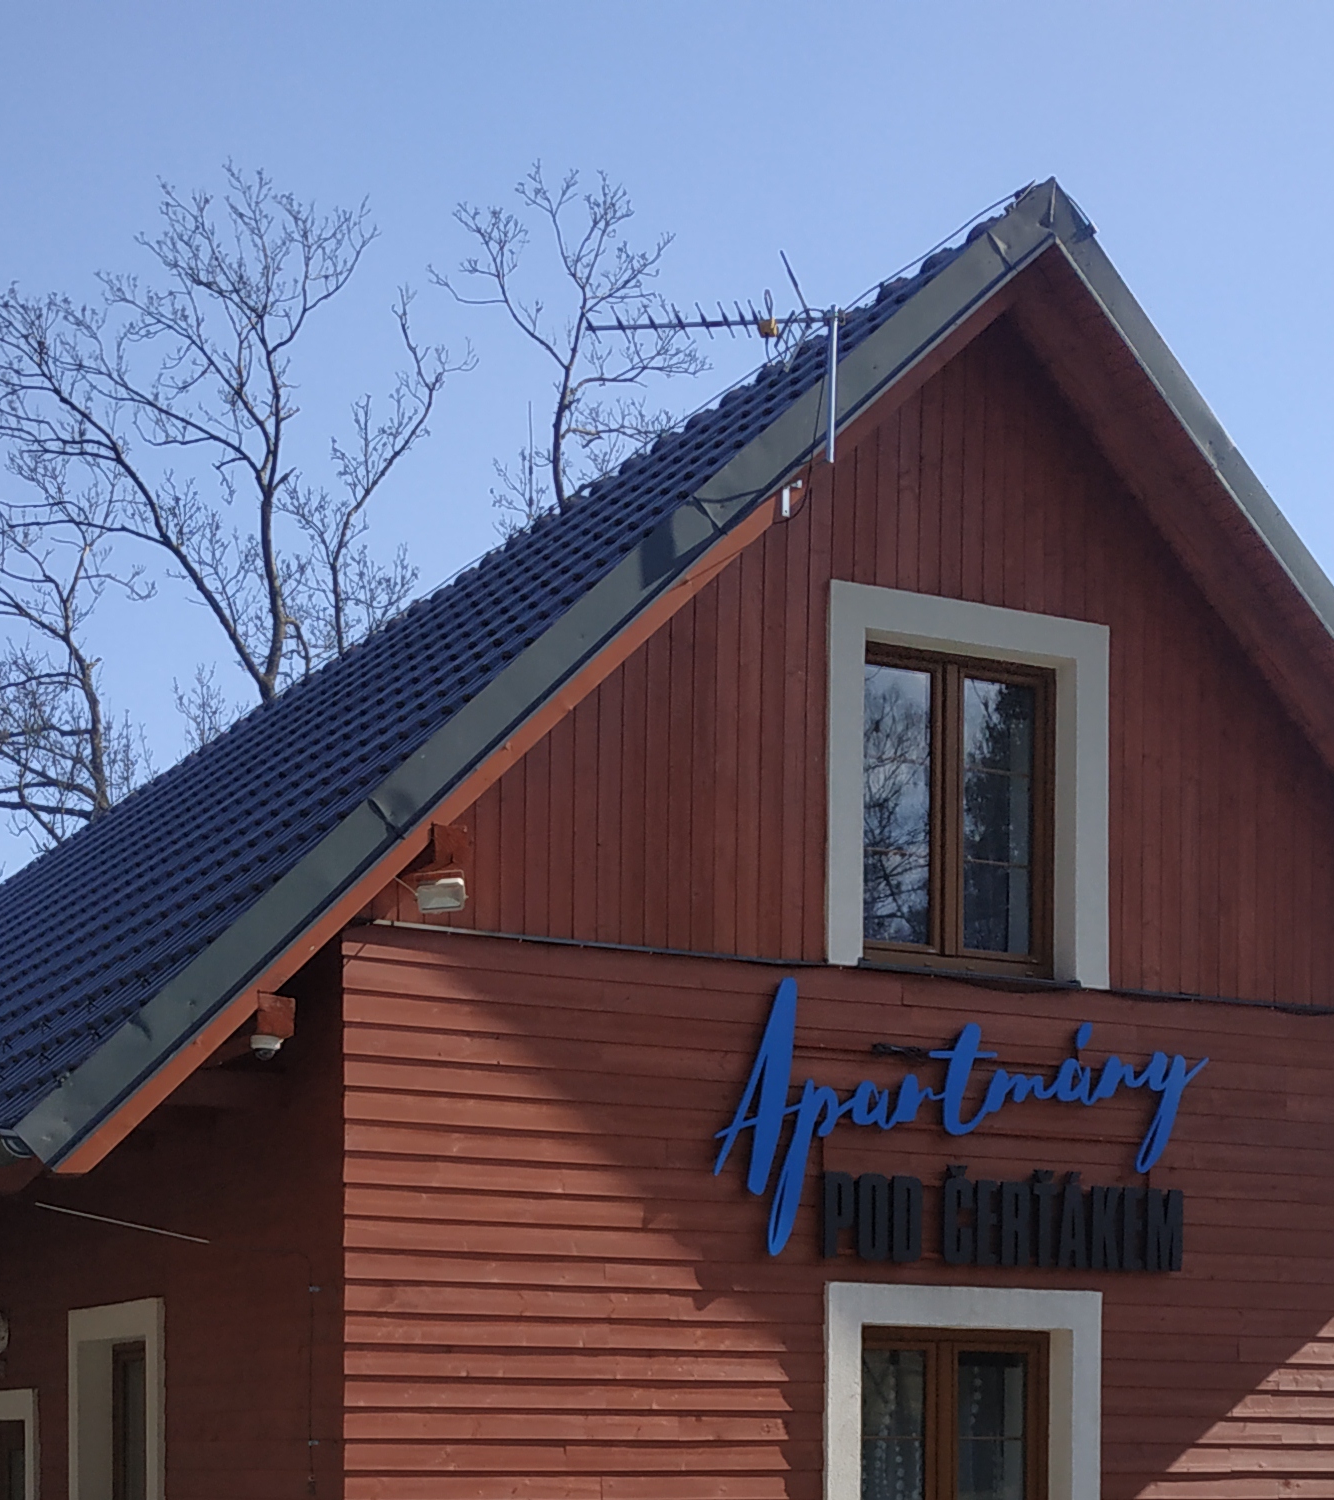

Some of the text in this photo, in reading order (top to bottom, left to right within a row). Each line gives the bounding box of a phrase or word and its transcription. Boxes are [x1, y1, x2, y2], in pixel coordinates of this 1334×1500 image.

[714, 977, 1209, 1256] Apartmány
[823, 1164, 1184, 1271] POD ČERŤÁKEM
